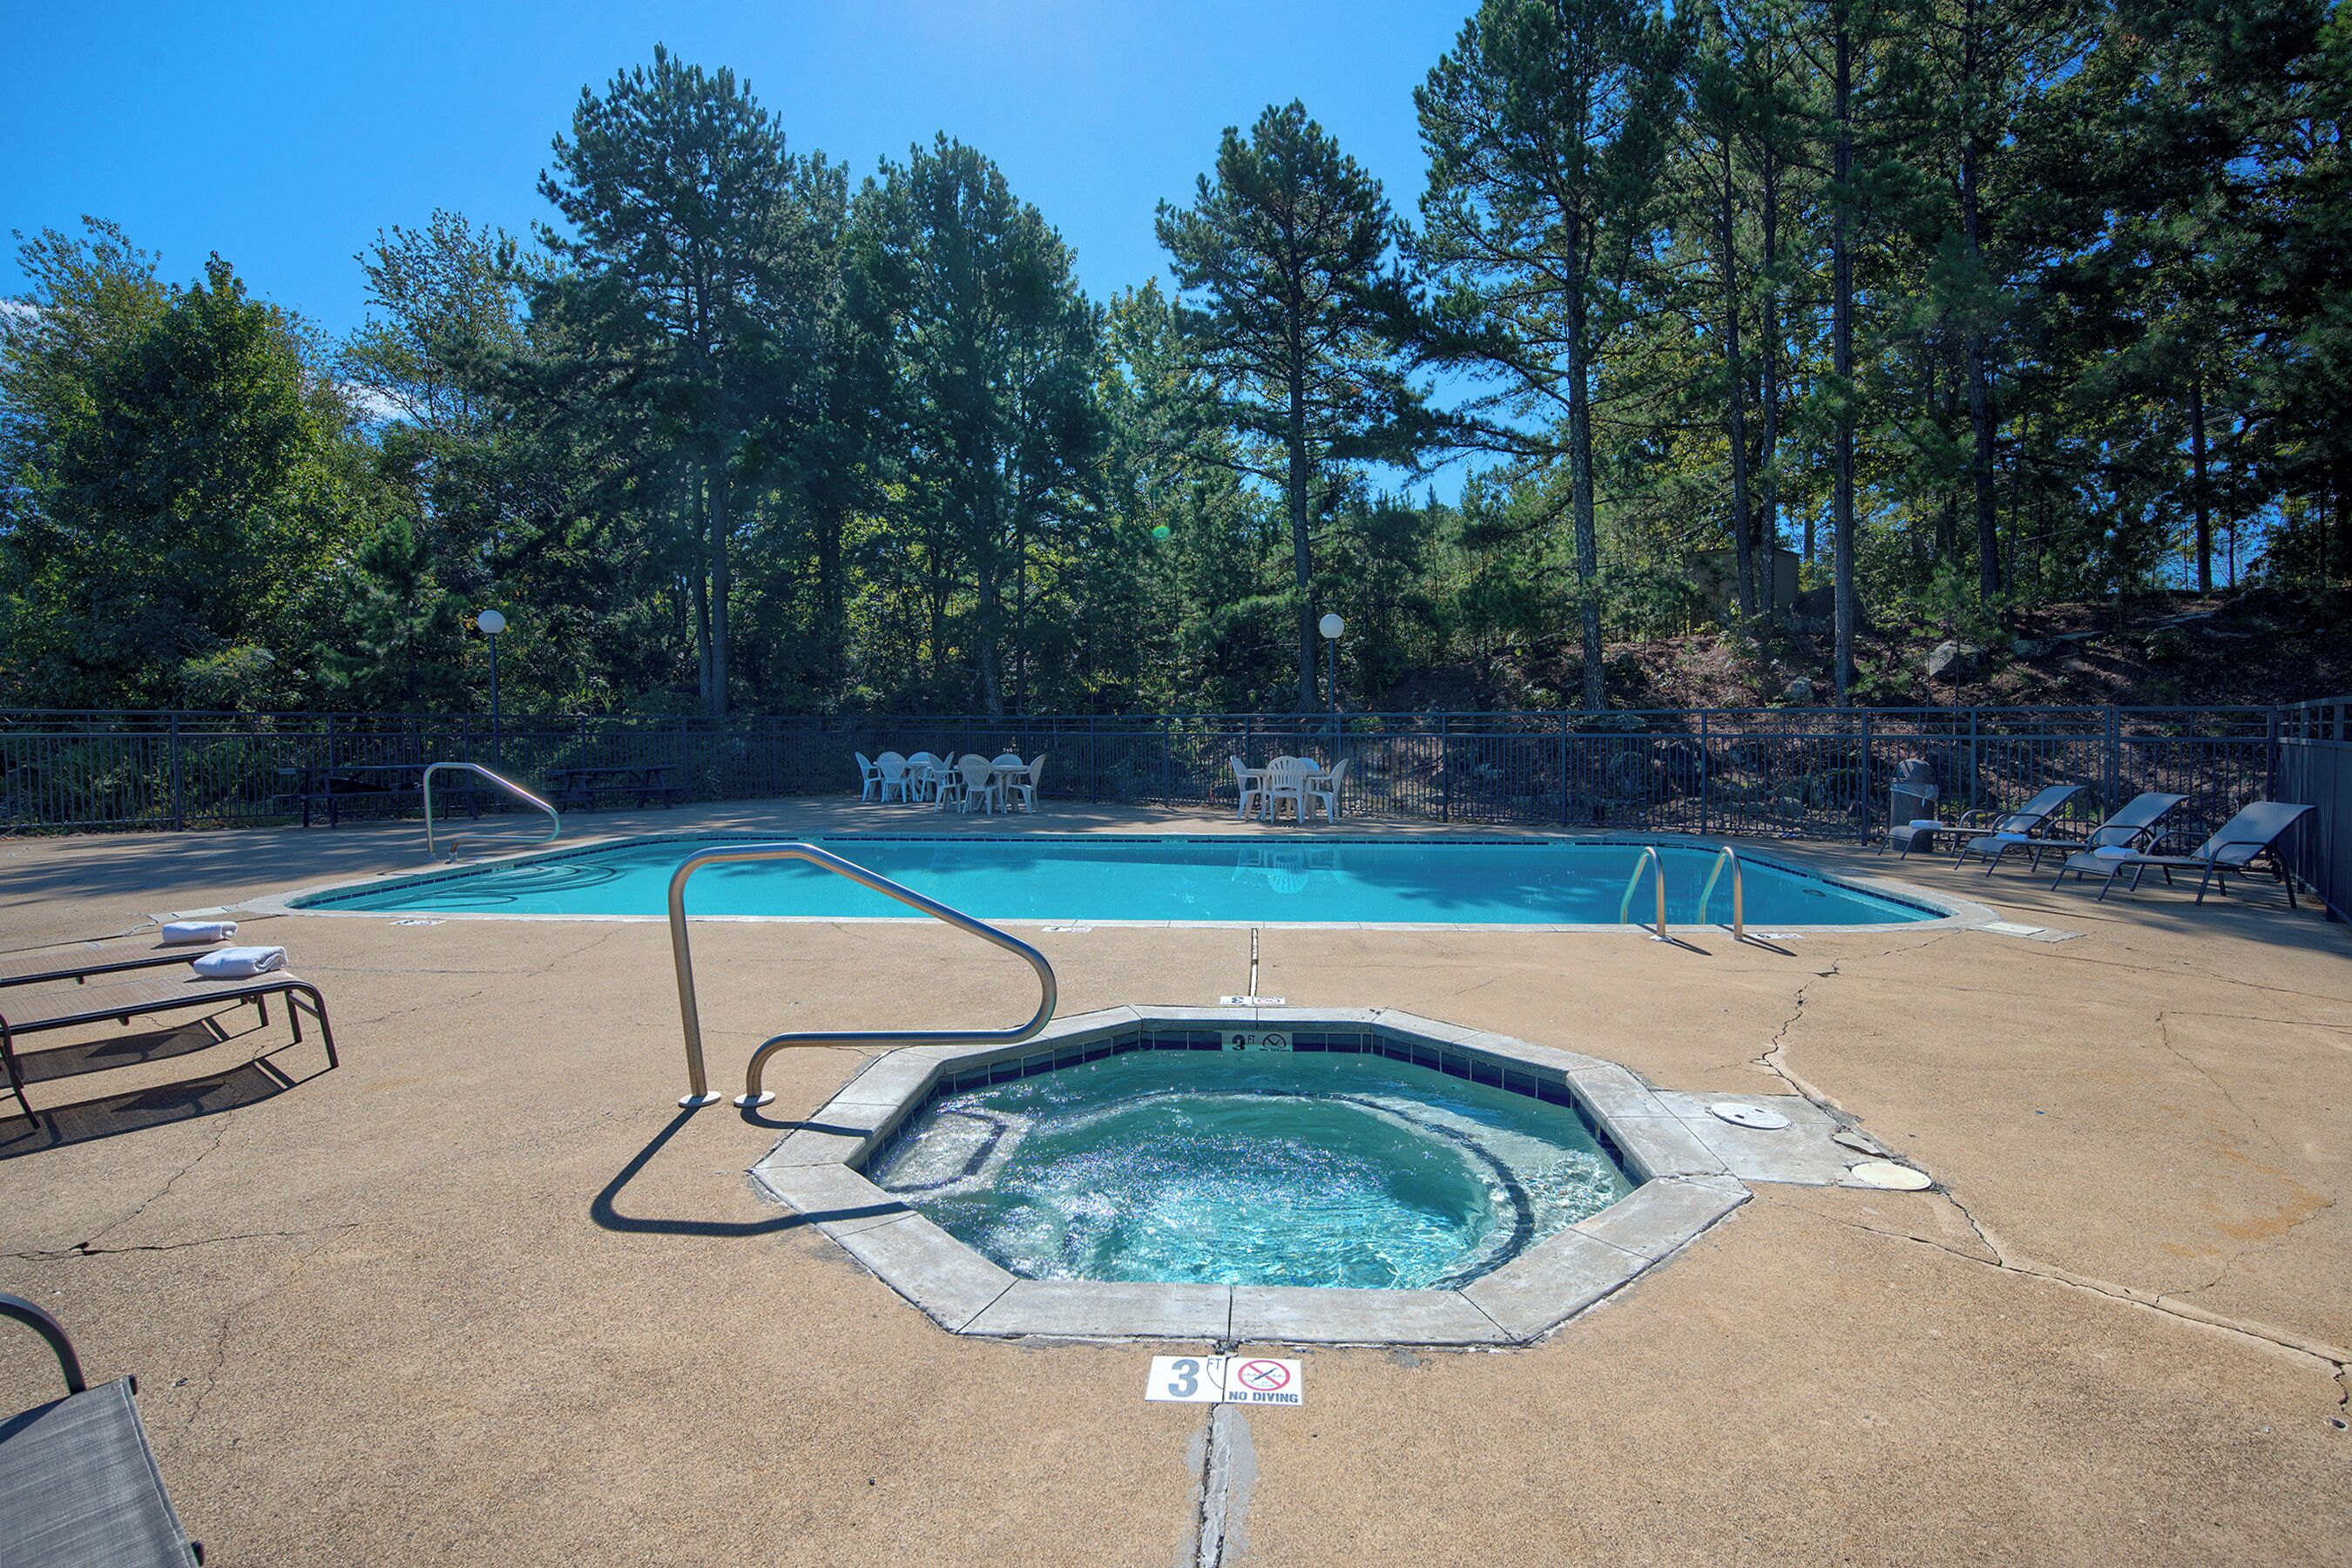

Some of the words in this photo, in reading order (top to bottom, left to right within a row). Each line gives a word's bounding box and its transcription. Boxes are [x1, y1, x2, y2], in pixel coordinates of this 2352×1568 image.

[1232, 1034, 1246, 1051] 3
[1247, 1035, 1255, 1044] FT
[1167, 1359, 1200, 1398] 3
[1207, 1357, 1223, 1370] FT
[1228, 1390, 1247, 1402] NO
[1252, 1391, 1299, 1403] DIVING
